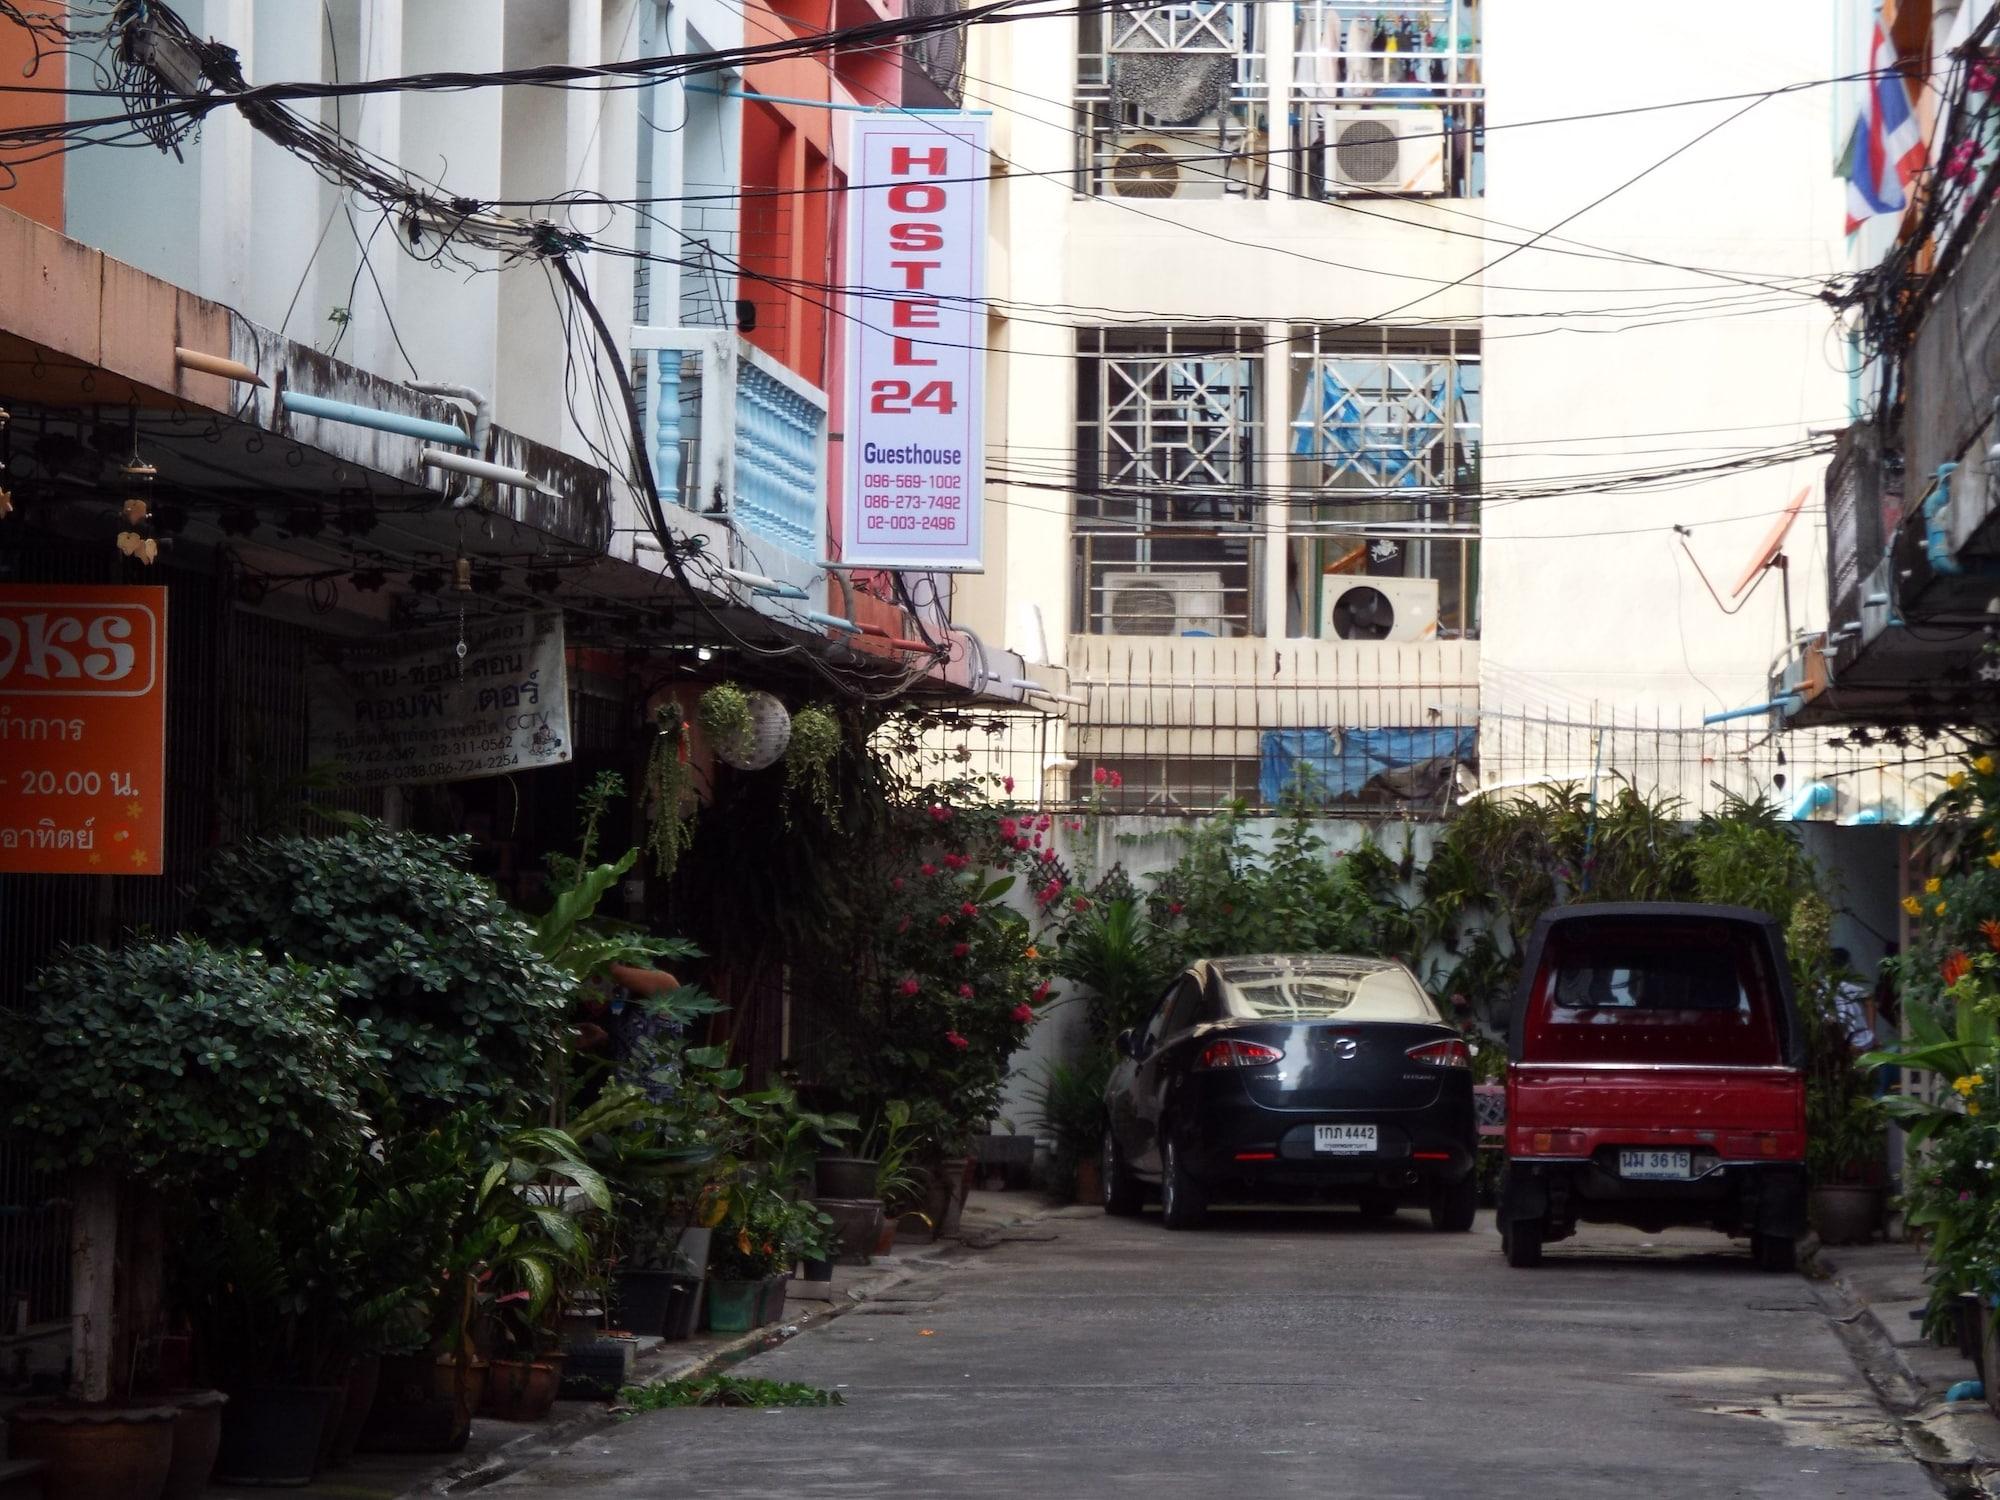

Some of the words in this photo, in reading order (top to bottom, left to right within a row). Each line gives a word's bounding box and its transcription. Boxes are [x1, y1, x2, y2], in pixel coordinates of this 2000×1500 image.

[886, 147, 948, 367] HOSTEL
[870, 379, 957, 415] 24
[864, 442, 961, 465] Guesthouse
[865, 473, 961, 489] 096-569-1002
[865, 494, 961, 510] 086-273-7492
[867, 516, 956, 531] 02-003-2496
[504, 710, 550, 732] CCTV
[20, 770, 101, 797] 20.00
[1345, 1127, 1375, 1139] 4442
[1650, 1153, 1689, 1168] 3615
